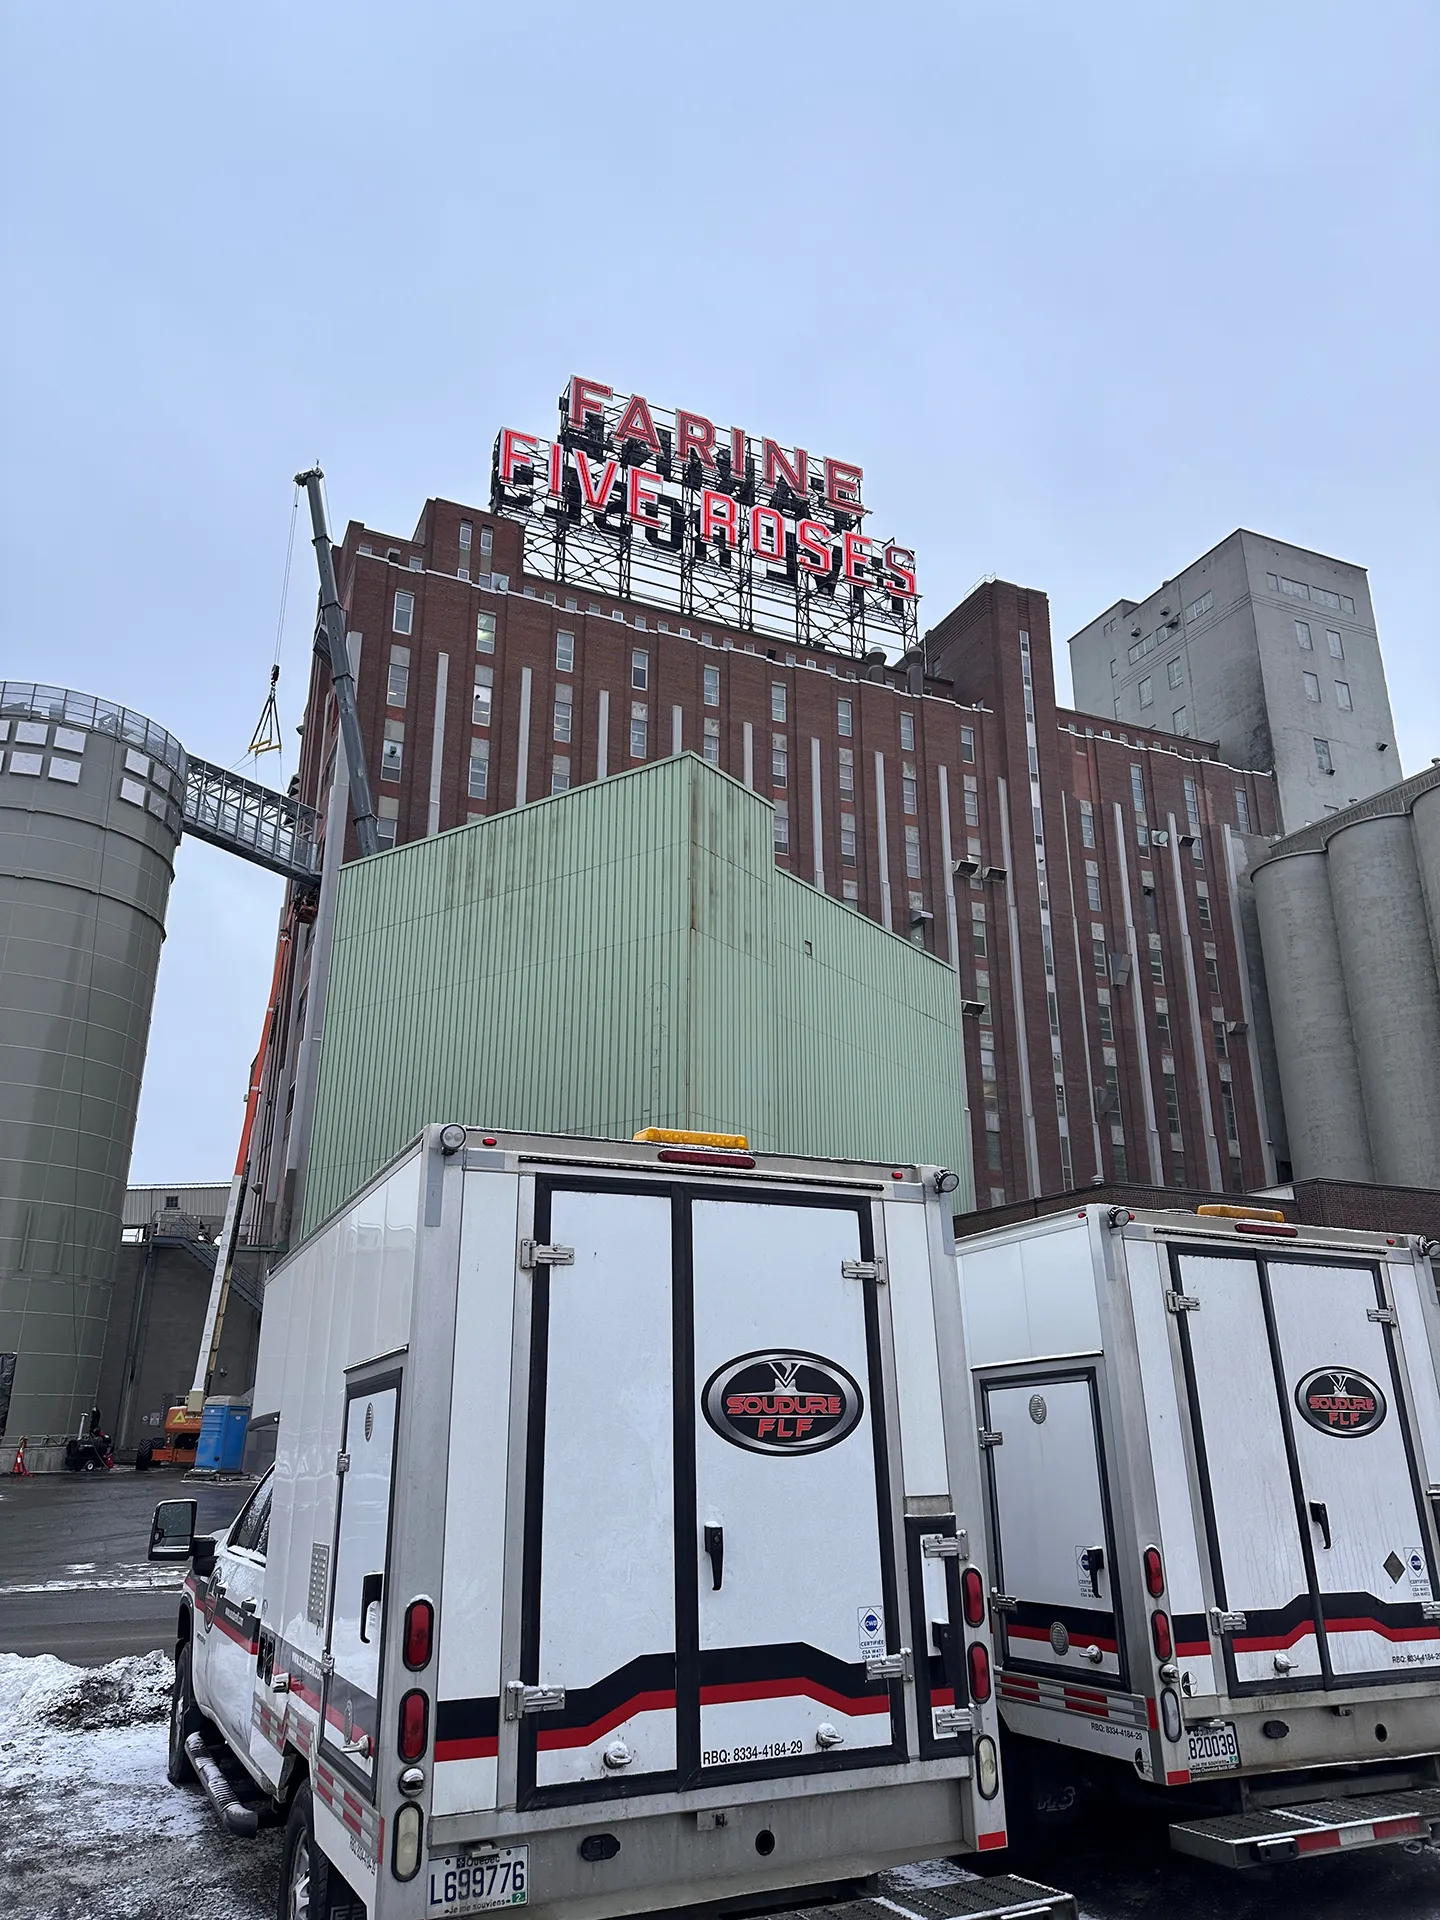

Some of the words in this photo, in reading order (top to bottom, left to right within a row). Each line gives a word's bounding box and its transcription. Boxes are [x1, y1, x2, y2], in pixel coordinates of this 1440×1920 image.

[569, 374, 864, 515] FARINE
[499, 427, 664, 527] FIVE
[699, 488, 917, 599] ROSES
[726, 1396, 842, 1414] SOUDURE
[1309, 1397, 1375, 1411] SOUDURE
[757, 1418, 814, 1438] FLF
[1328, 1412, 1360, 1425] FLF
[1106, 1725, 1142, 1740] 8334-4184-29
[703, 1749, 731, 1765] RBQ:
[734, 1740, 803, 1761] 8334-4184-29
[1188, 1733, 1236, 1760] 820038
[430, 1860, 525, 1905] L699776
[450, 1905, 458, 1914] Je
[473, 1899, 506, 1911] souviens
